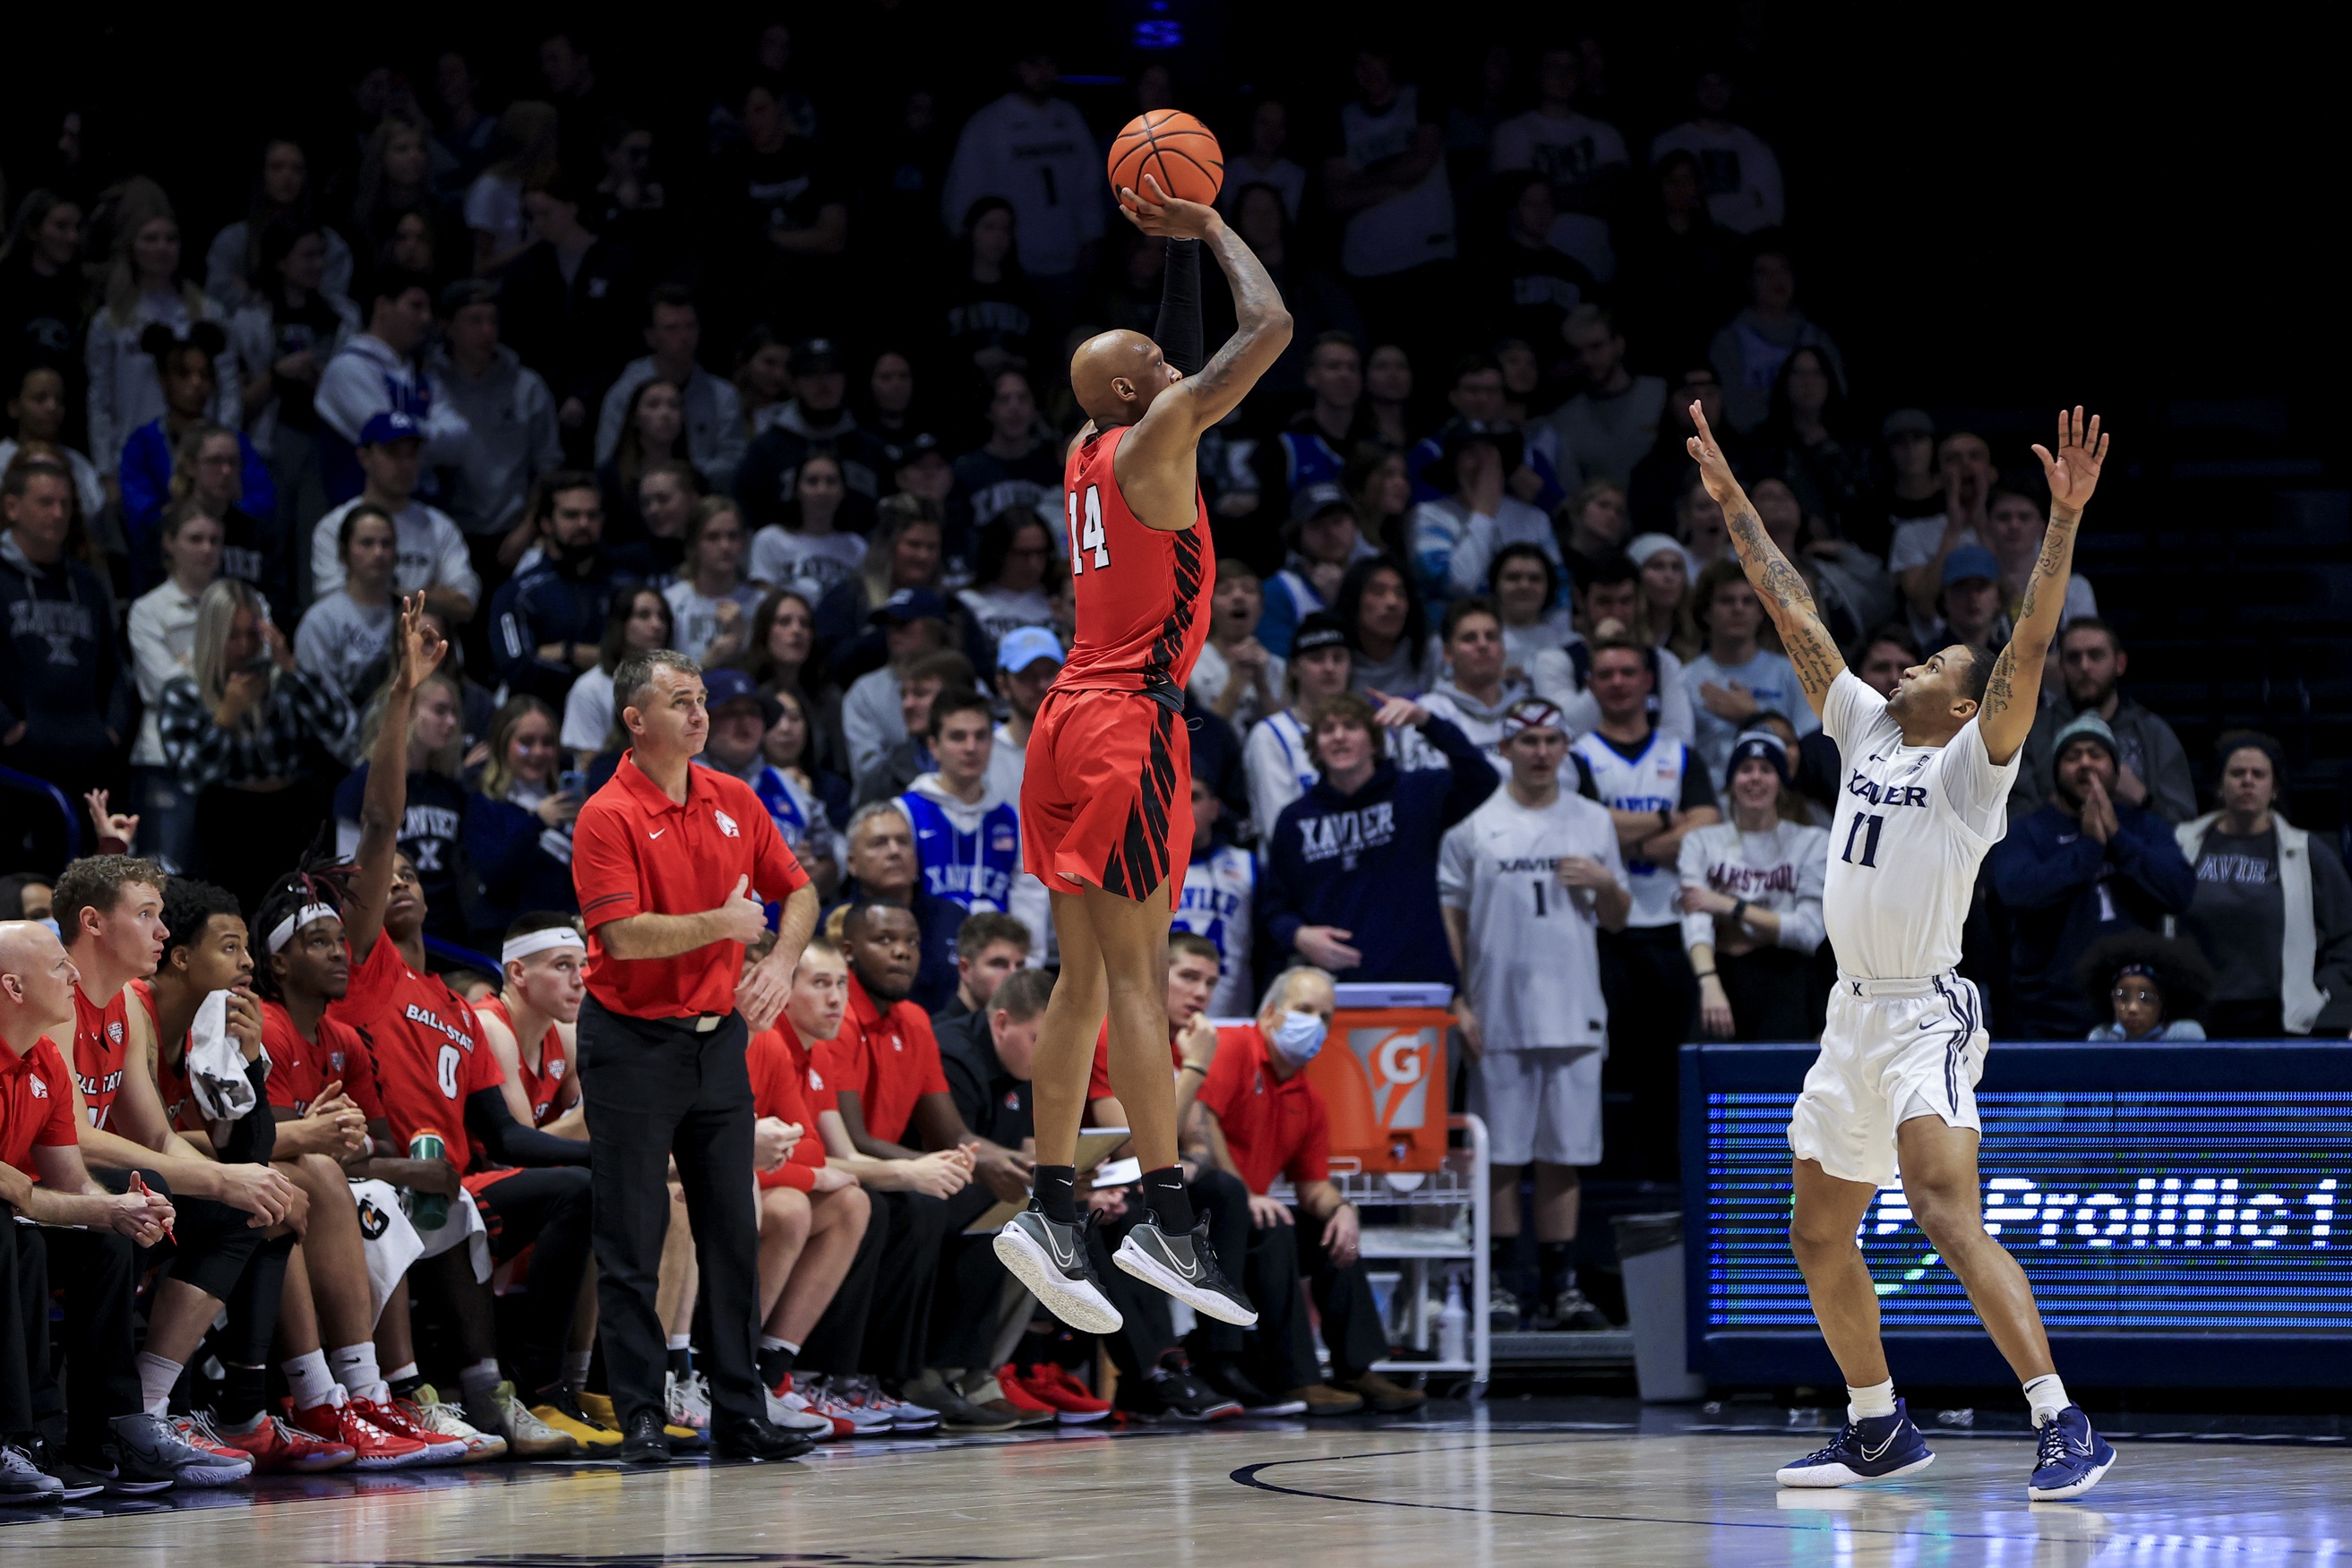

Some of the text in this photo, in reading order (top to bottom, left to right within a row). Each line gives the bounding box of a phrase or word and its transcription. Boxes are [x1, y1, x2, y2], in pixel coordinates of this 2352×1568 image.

[1069, 484, 1111, 576] 14
[1847, 768, 1927, 808] XAVER
[395, 804, 461, 844] AVIER
[1295, 800, 1395, 855] XAVIER
[1841, 811, 1884, 869] 11
[1498, 857, 1560, 872] XAVIE
[2196, 853, 2278, 885] AVIE
[1532, 880, 1547, 916] 1
[1851, 981, 1863, 997] X
[405, 1003, 447, 1033] BALL
[437, 1043, 461, 1101] 0
[1378, 1034, 1422, 1084] G
[75, 1072, 99, 1094] AL
